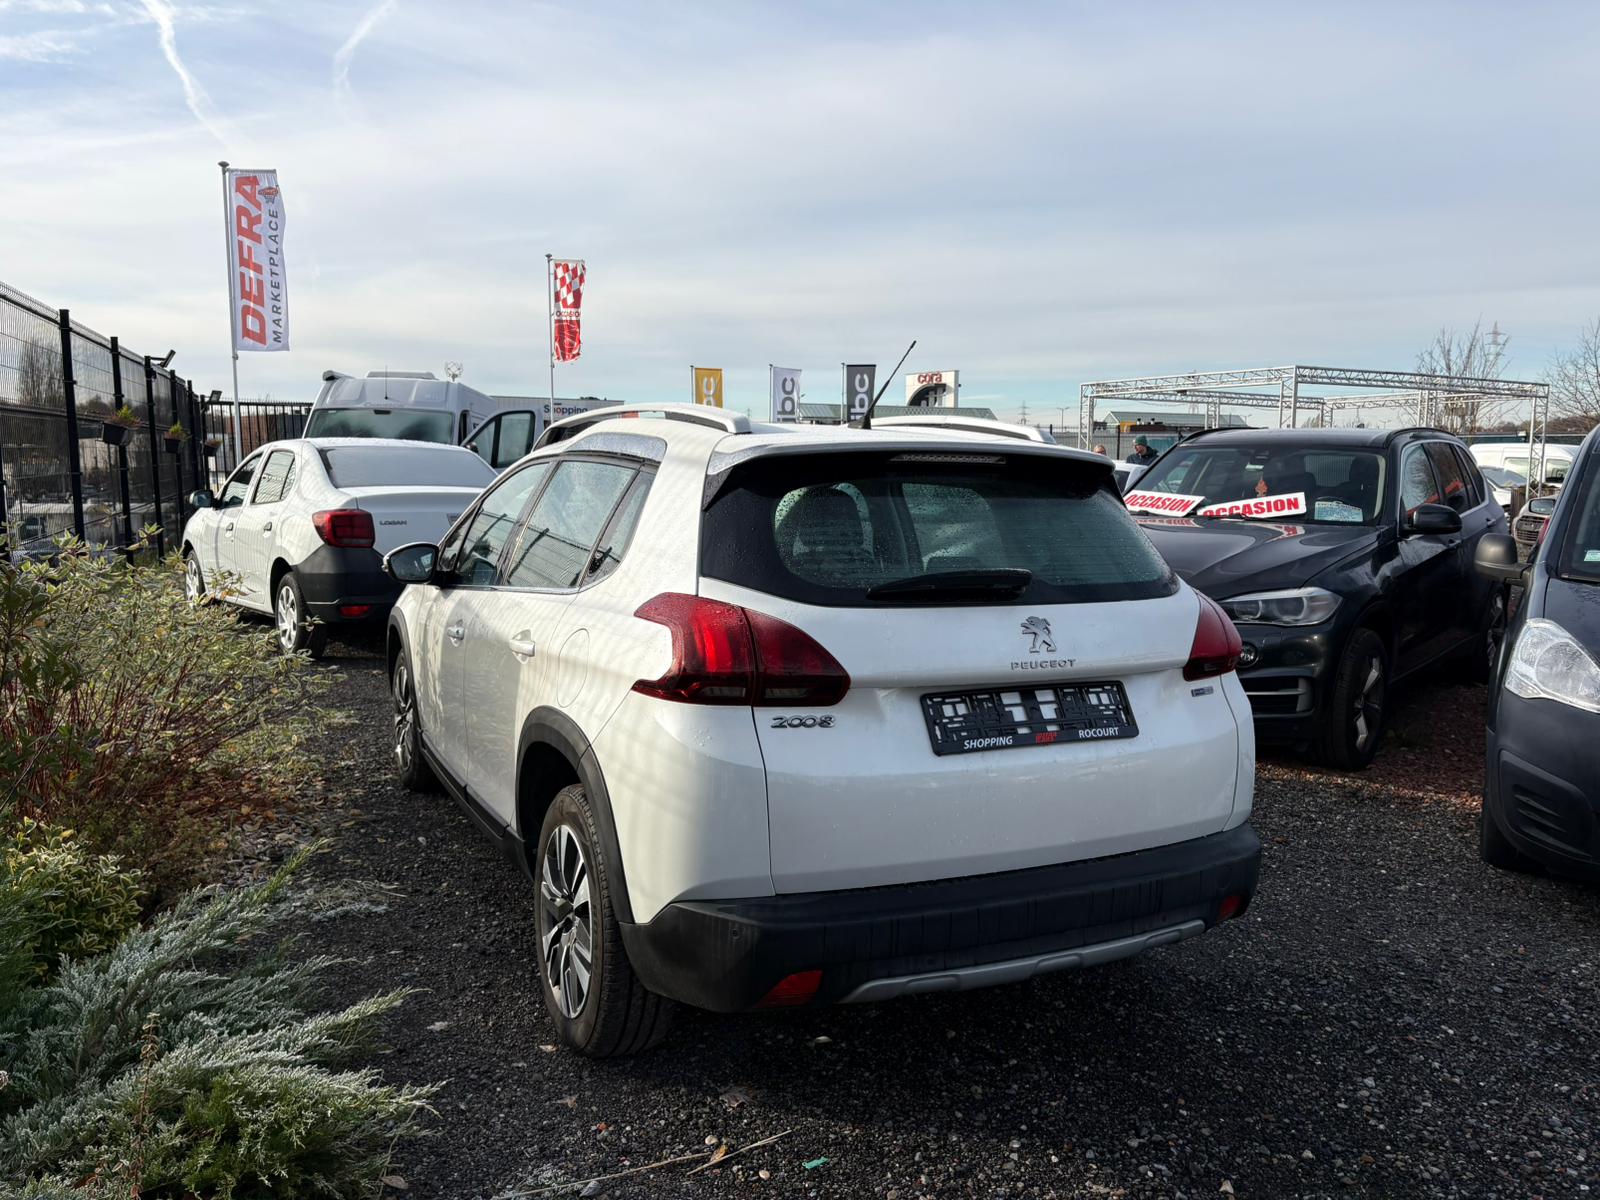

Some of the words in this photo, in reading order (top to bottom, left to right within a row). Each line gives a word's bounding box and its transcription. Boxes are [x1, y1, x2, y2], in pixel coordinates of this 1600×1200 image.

[235, 175, 267, 346] DEFRA
[268, 208, 283, 344] MARKETPLACE
[917, 371, 943, 384] cora
[1124, 493, 1195, 513] OCCASION
[1010, 658, 1077, 671] PEUGEOT
[770, 714, 836, 729] 2008
[963, 735, 1013, 750] SHOPPING
[1078, 726, 1119, 739] ROCOURT
